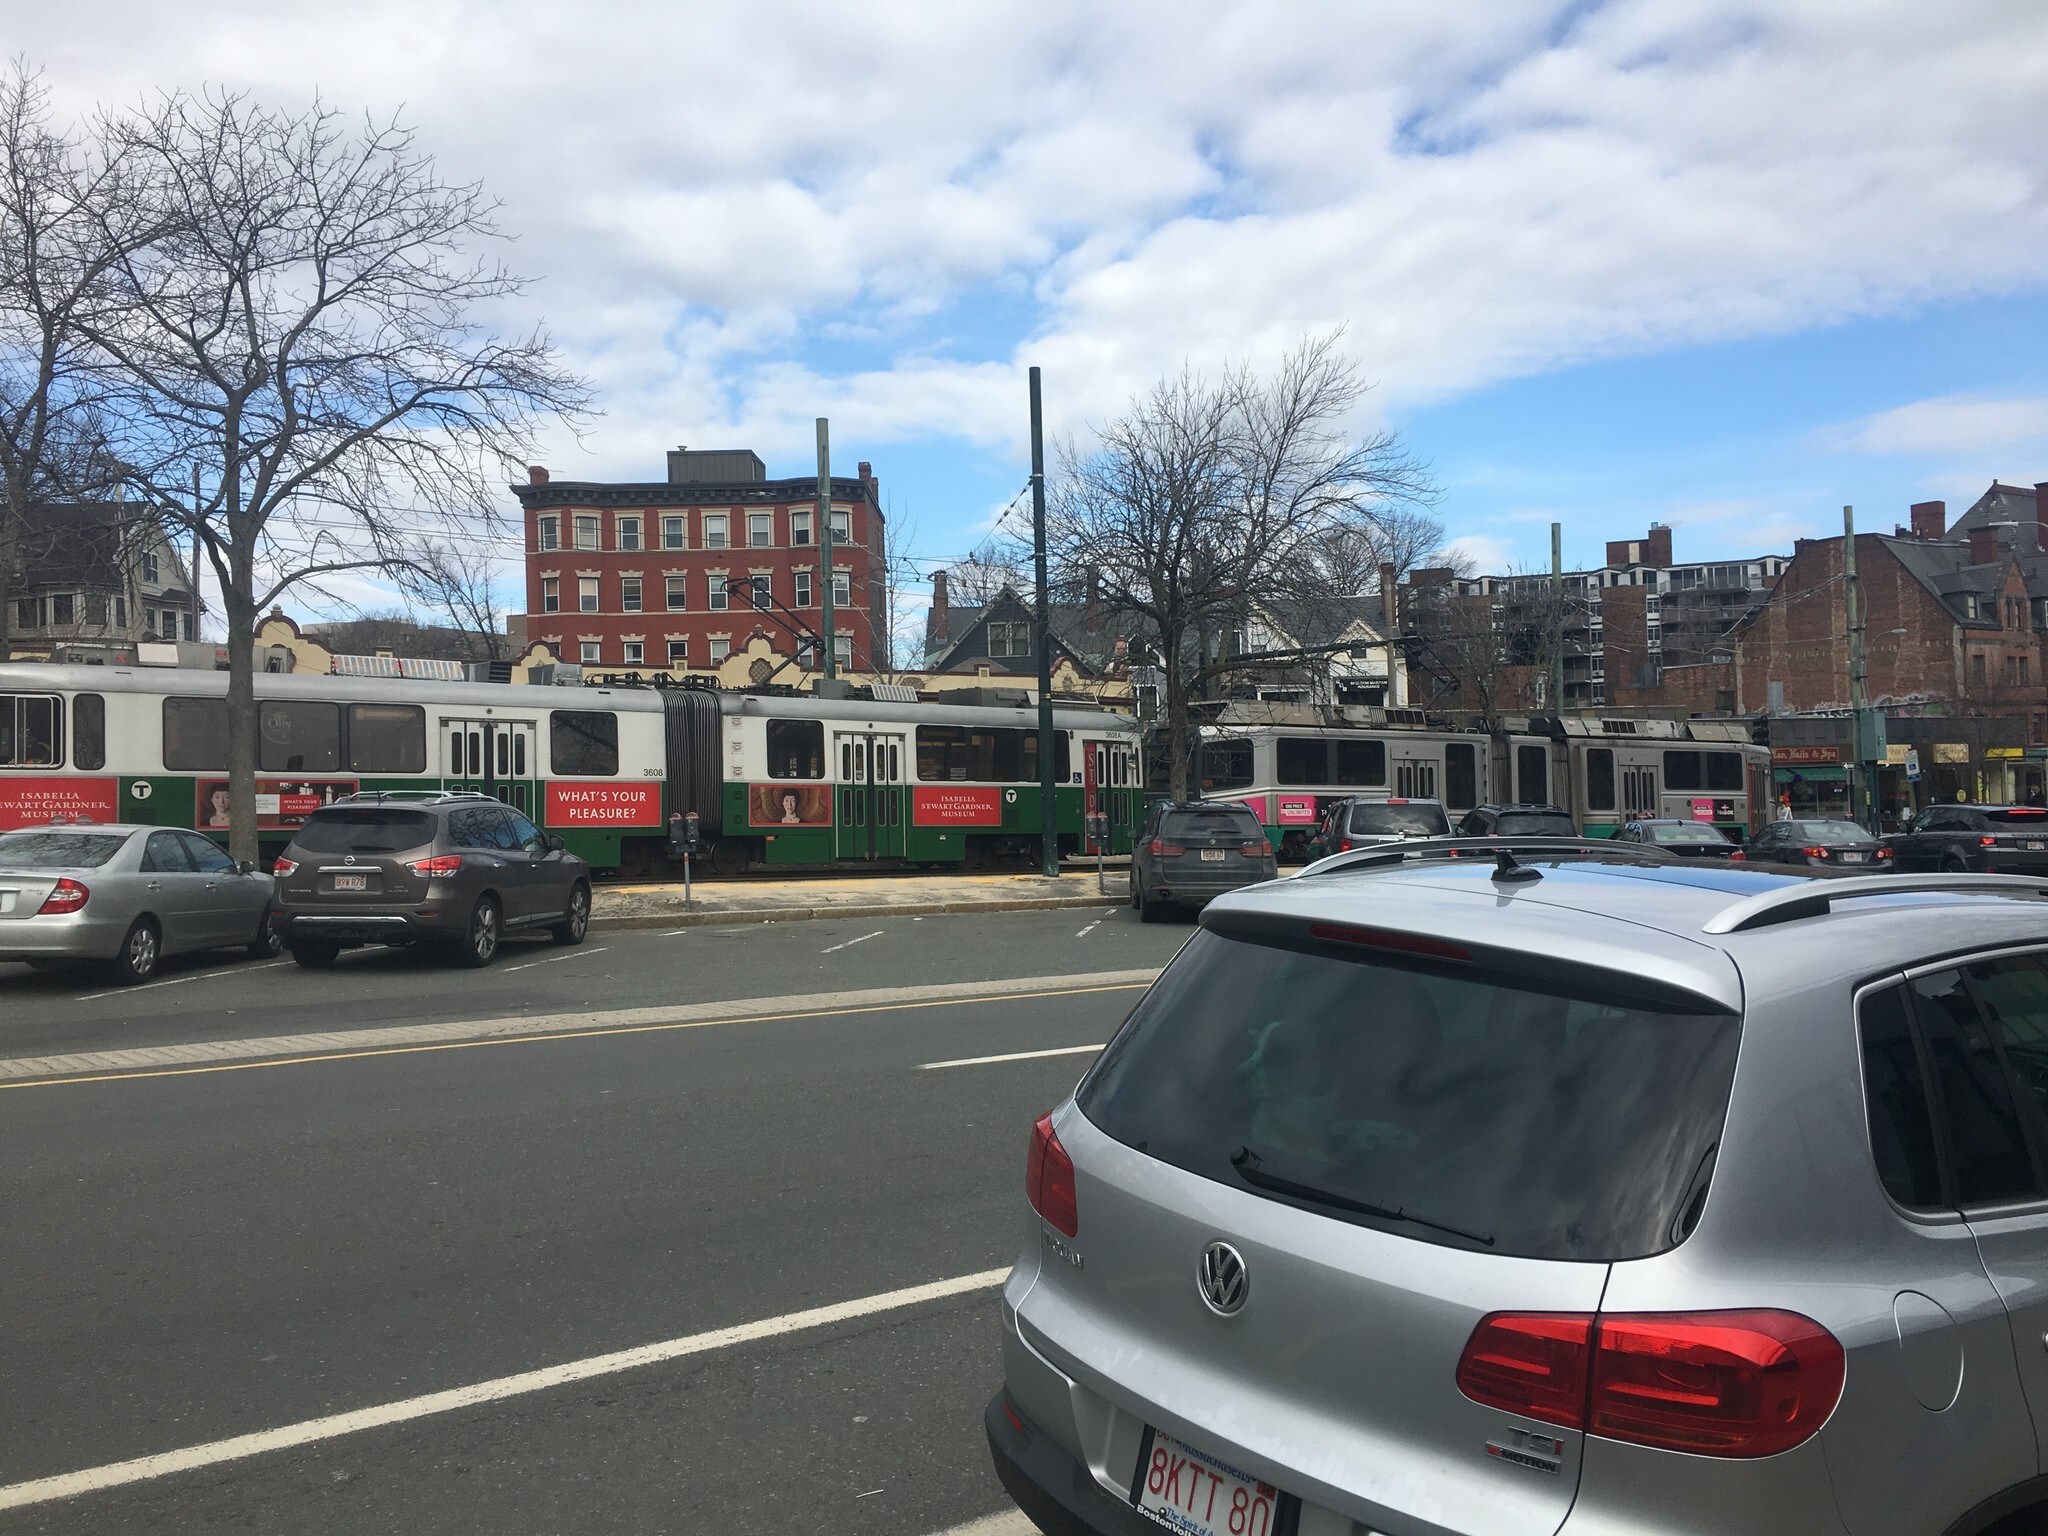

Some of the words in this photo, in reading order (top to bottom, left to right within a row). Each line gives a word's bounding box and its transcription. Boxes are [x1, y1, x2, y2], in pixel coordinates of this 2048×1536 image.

[1789, 749, 1809, 760] Nails
[1812, 750, 1820, 758] &
[1820, 747, 1836, 760] Spa
[643, 769, 664, 777] 3608
[20, 792, 80, 800] ISABELLA
[558, 791, 608, 802] WHAT'S
[612, 791, 647, 802] YOUR
[42, 800, 111, 809] GARDNER
[953, 802, 994, 810] GARDNER
[569, 808, 637, 819] PLEASURE?
[1148, 1447, 1223, 1523] 8KTT
[1229, 1487, 1270, 1536] 80
[1167, 1507, 1179, 1521] The
[1180, 1515, 1198, 1532] Spirit
